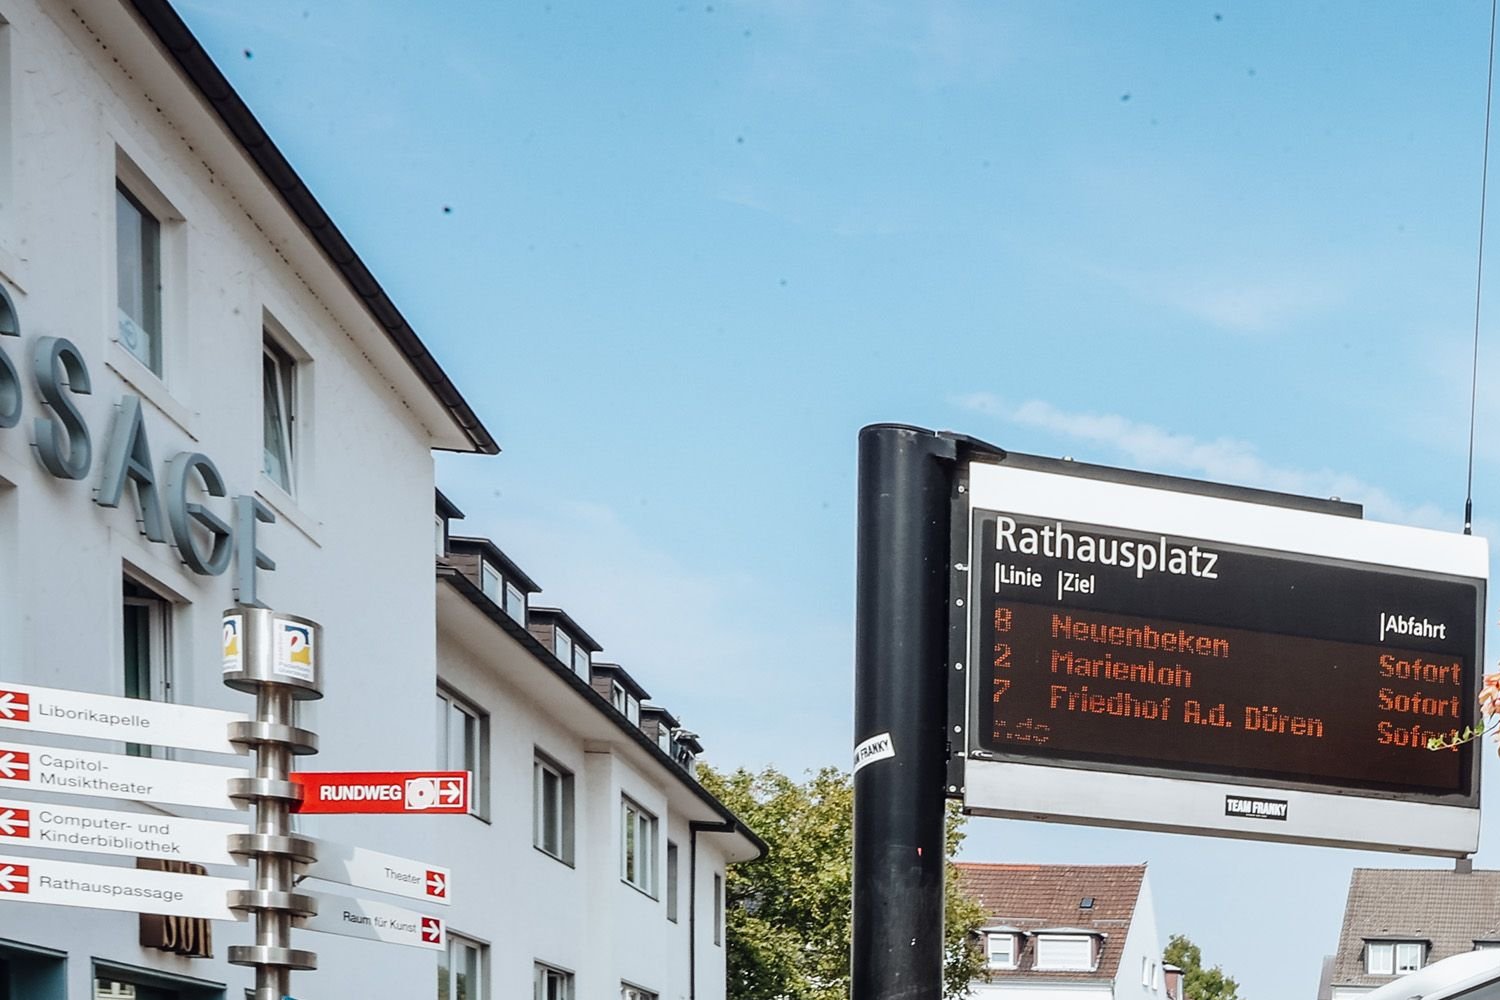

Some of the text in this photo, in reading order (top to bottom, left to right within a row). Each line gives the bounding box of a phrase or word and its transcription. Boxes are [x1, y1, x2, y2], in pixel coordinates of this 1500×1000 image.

[995, 515, 1219, 579] Rathausplatz
[1000, 564, 1095, 594] Linie Ziel
[1385, 615, 1446, 640] Abfahrt
[994, 607, 1461, 686] 8 Neuenbeken Sofort
[994, 643, 1461, 719] 2 Marienloh Sofort
[39, 703, 151, 728] Liborikapelle
[993, 678, 1011, 703] 7
[1050, 685, 1171, 721] Friedhof
[1183, 699, 1232, 729] A.d.
[1244, 705, 1324, 738] Dören
[860, 740, 889, 760] FRANKY
[39, 754, 109, 772] Capitol-
[40, 772, 153, 795] Musiktheater
[320, 785, 402, 801] RUNDWEG
[1227, 798, 1287, 817] TEAM FRANKY
[39, 811, 170, 836] Computer- und
[40, 829, 181, 854] Kinderbibliothek
[40, 875, 184, 902] Rathauspassage
[384, 867, 421, 885] Theater
[343, 910, 417, 934] Raum für Kunst
